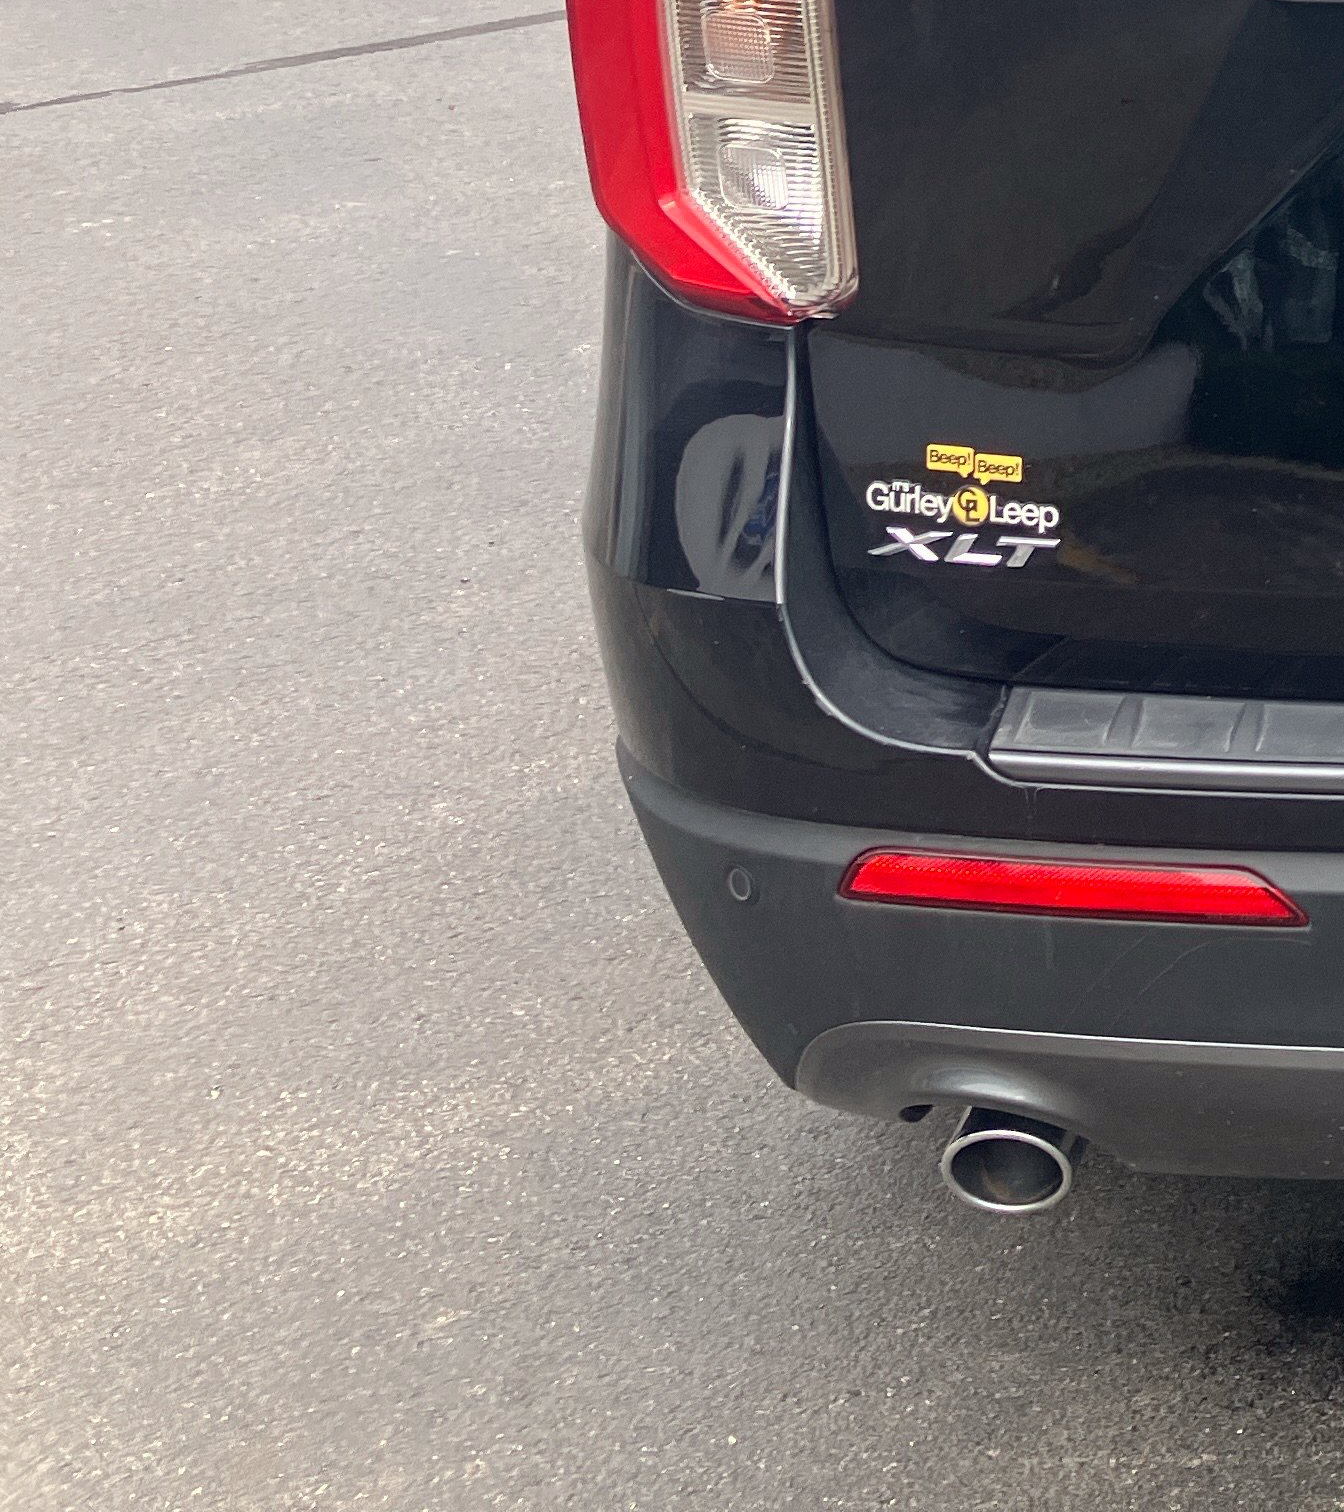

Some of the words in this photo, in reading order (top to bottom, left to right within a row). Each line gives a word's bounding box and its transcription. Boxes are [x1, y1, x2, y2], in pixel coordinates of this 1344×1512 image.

[929, 449, 971, 471] Beep!
[977, 459, 1020, 478] Beep!
[866, 481, 954, 524] Gurley
[989, 495, 1060, 534] Leep
[867, 526, 1062, 568] XLT
